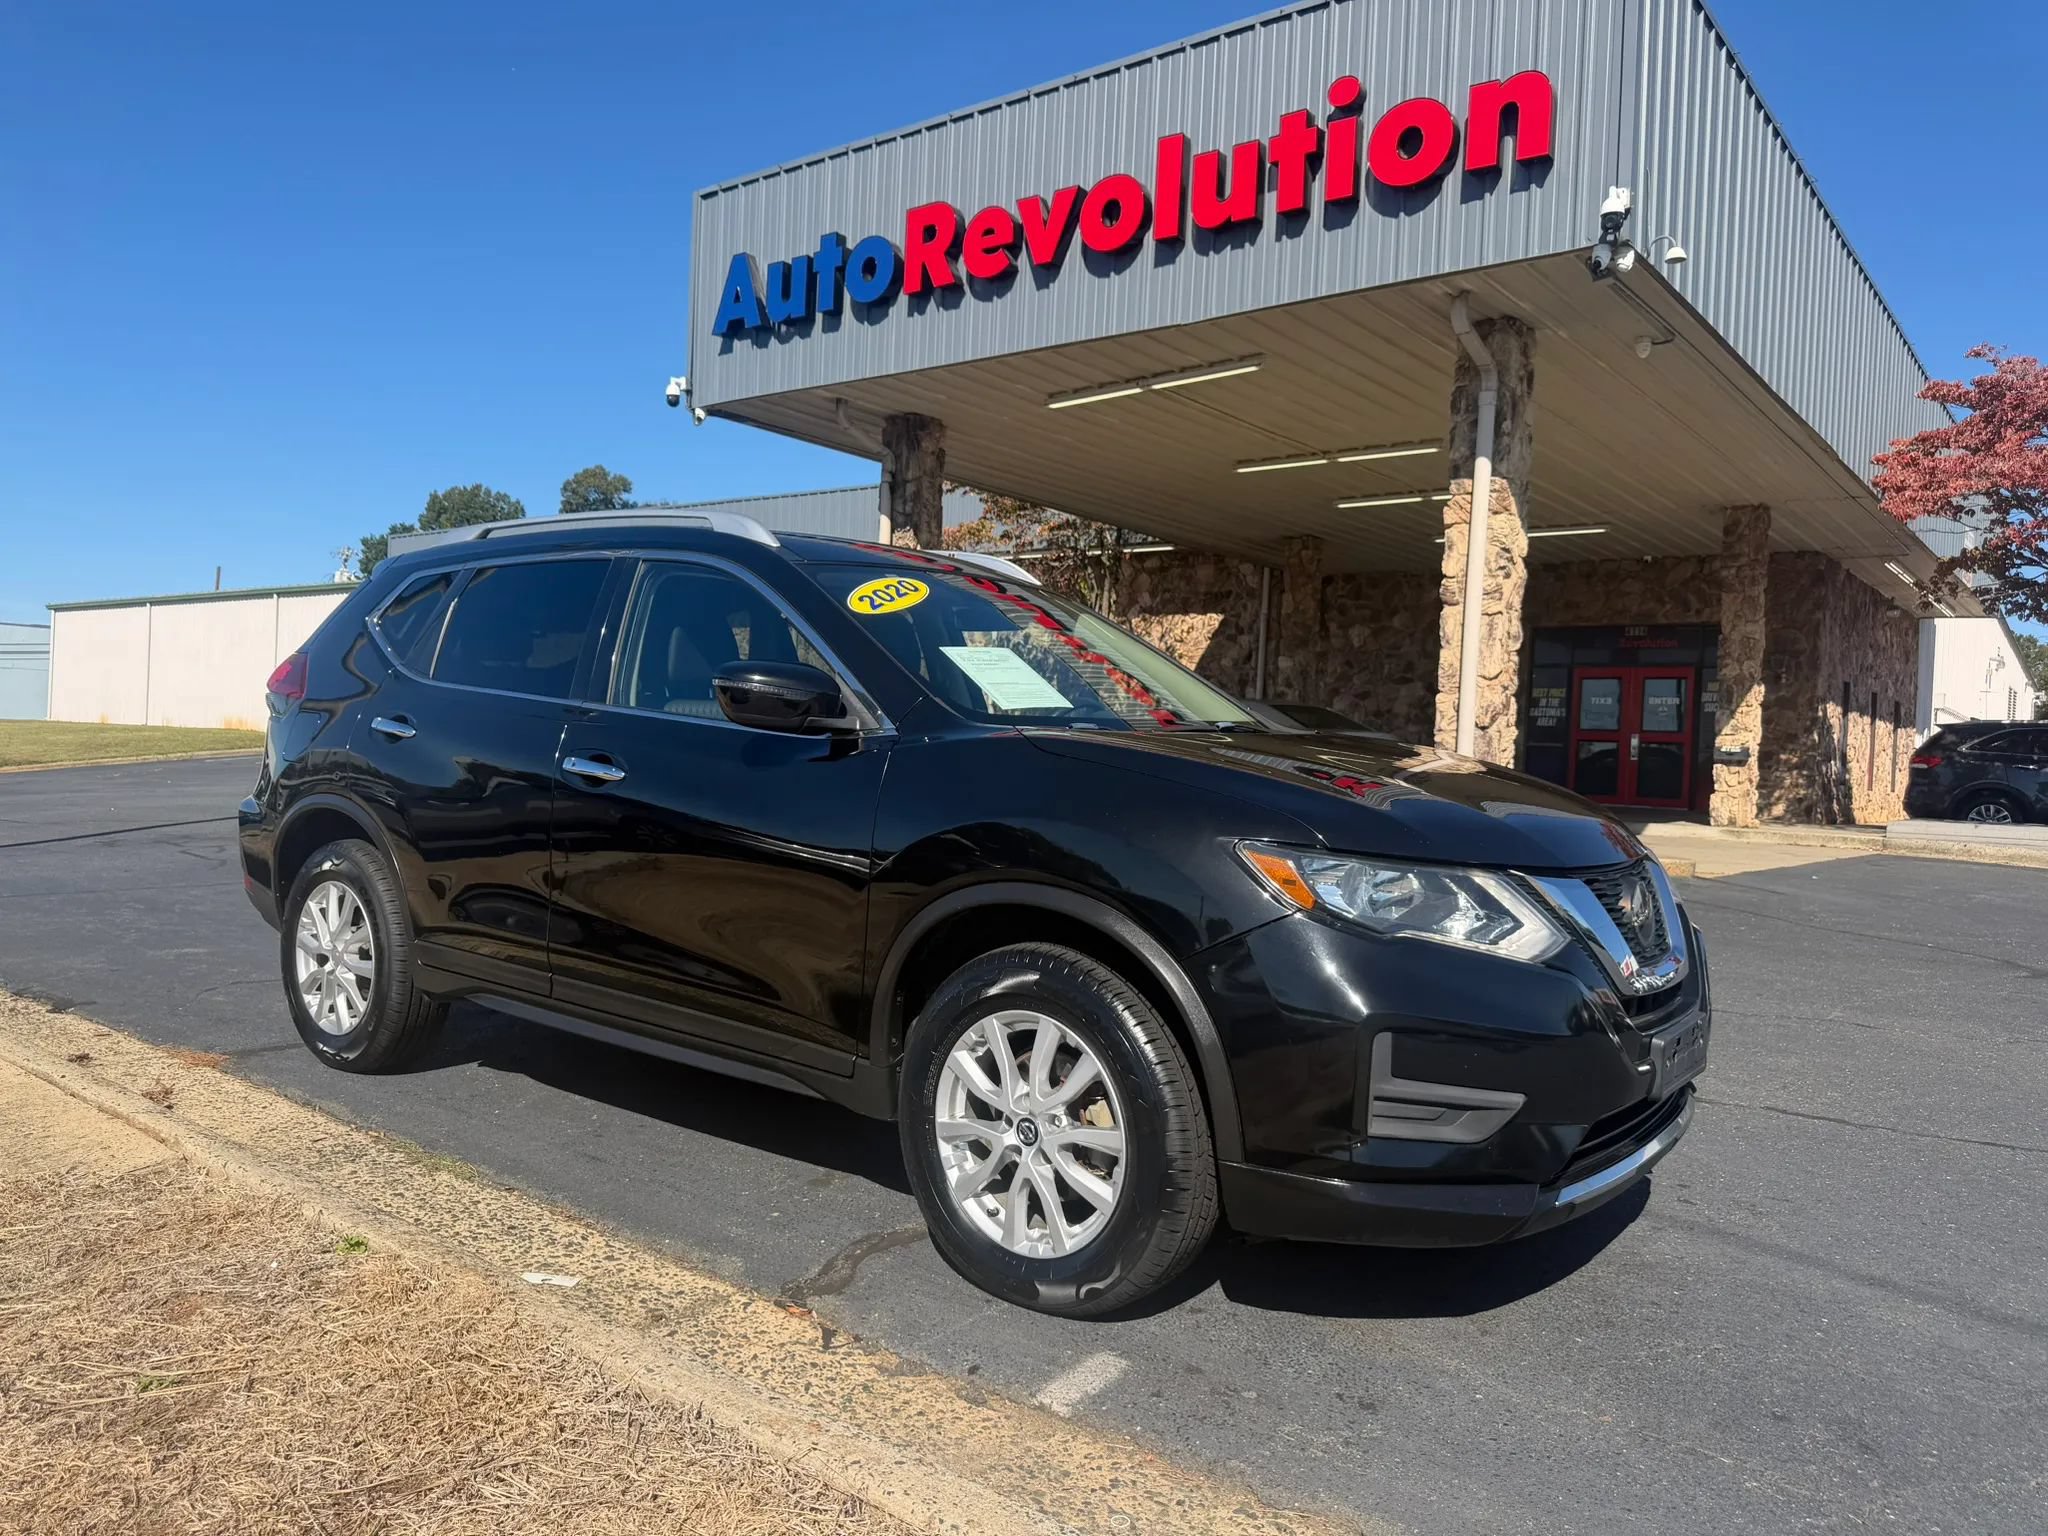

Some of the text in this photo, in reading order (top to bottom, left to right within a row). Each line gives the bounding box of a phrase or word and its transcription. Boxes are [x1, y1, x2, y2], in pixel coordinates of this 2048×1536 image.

[858, 580, 919, 610] 2020
[1539, 698, 1560, 707] IN THE
